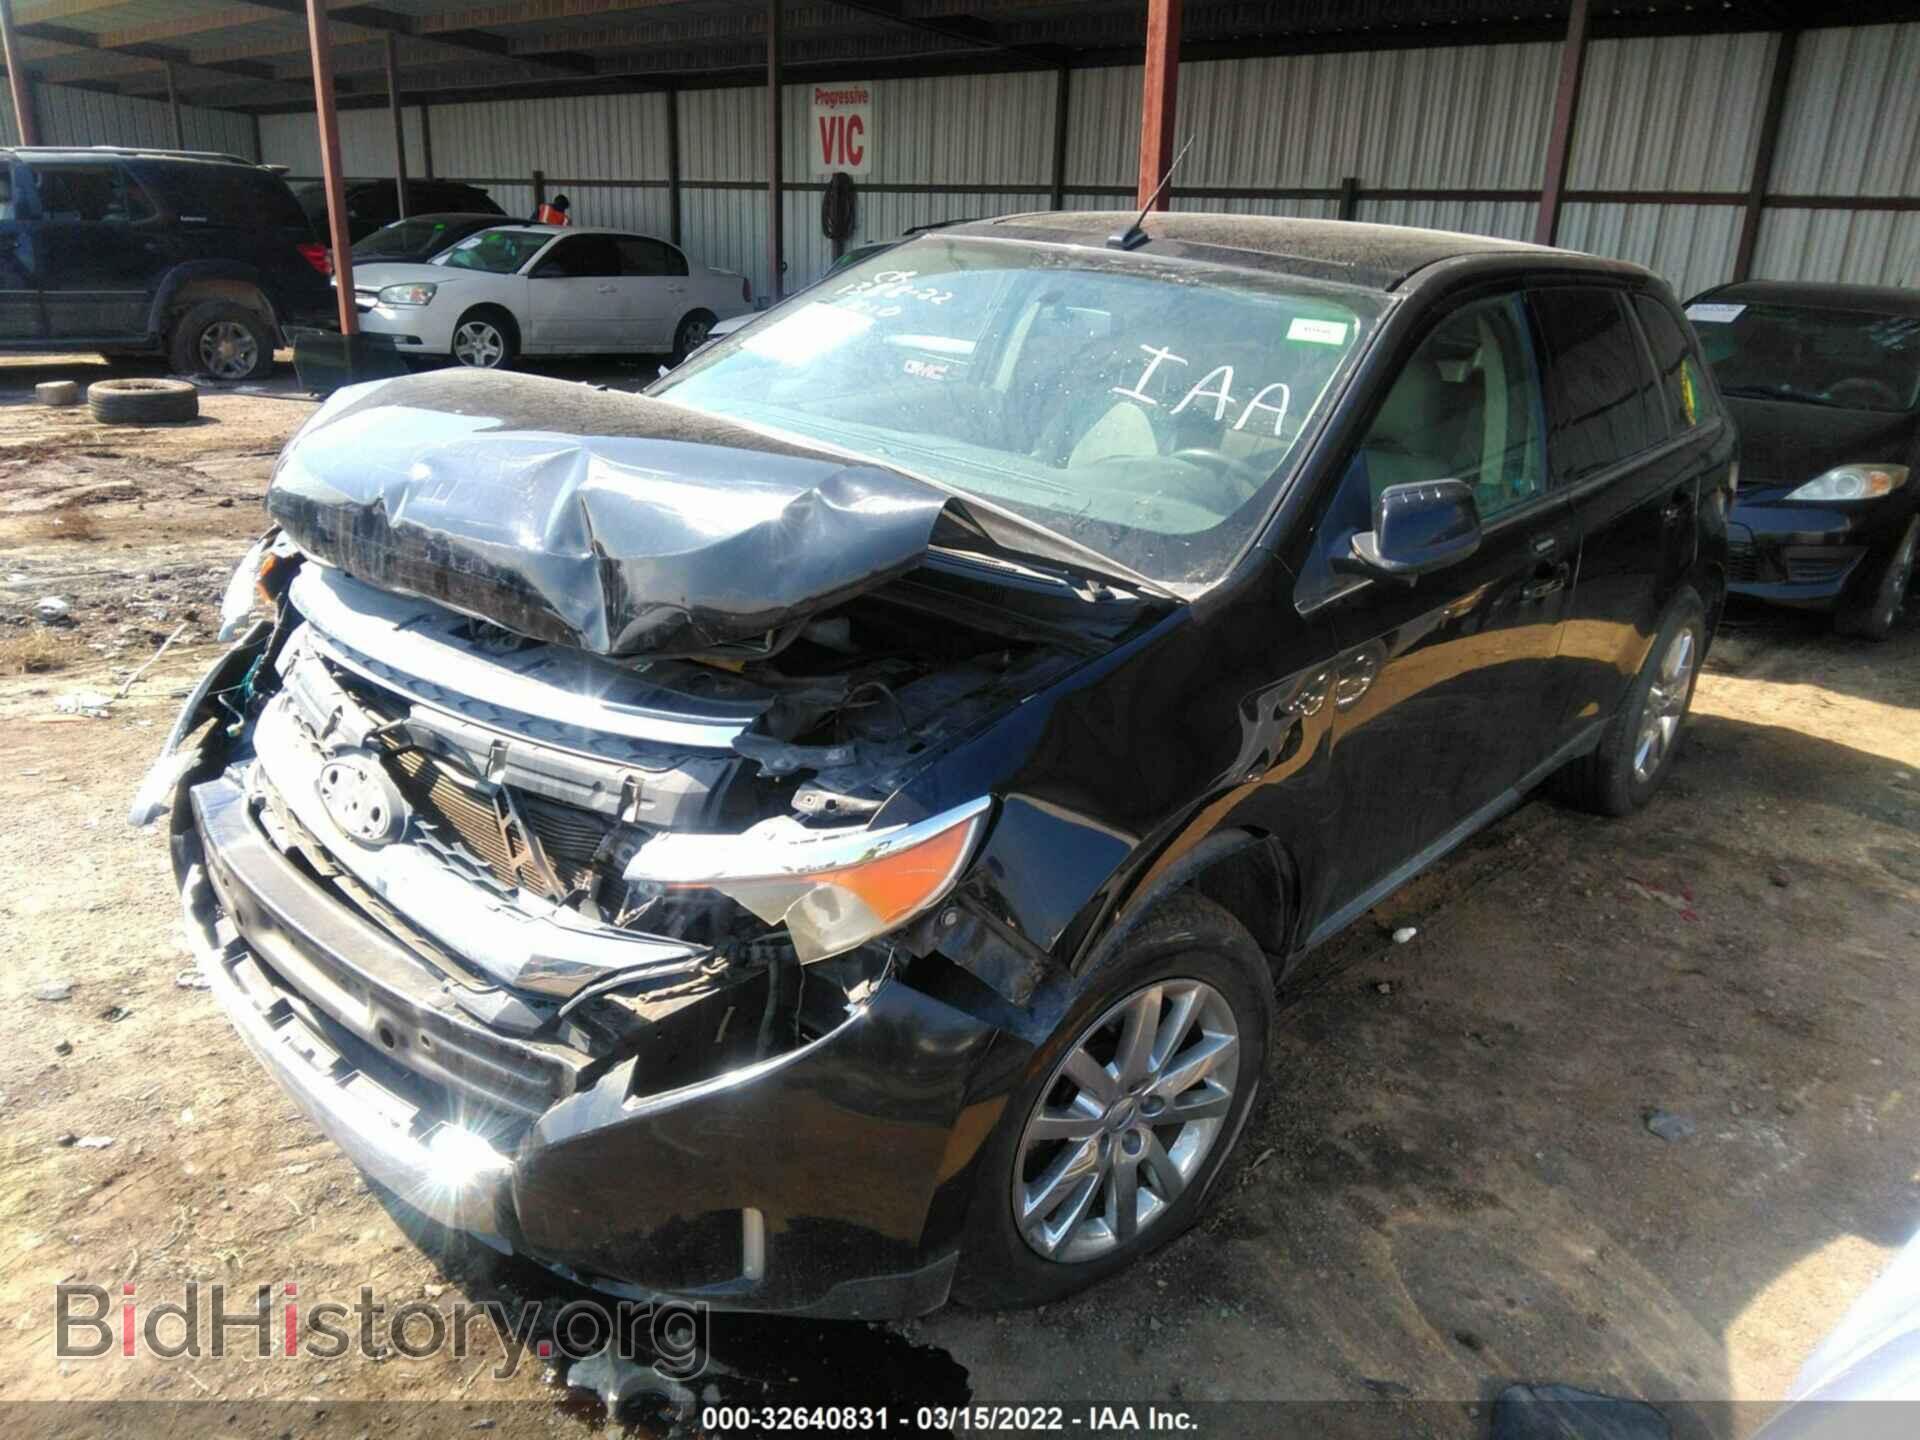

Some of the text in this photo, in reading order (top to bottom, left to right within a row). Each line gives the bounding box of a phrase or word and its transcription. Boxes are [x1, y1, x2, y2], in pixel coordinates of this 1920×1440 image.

[815, 86, 868, 109] Progressive
[819, 114, 864, 167] VIC
[1111, 344, 1289, 436] IAA
